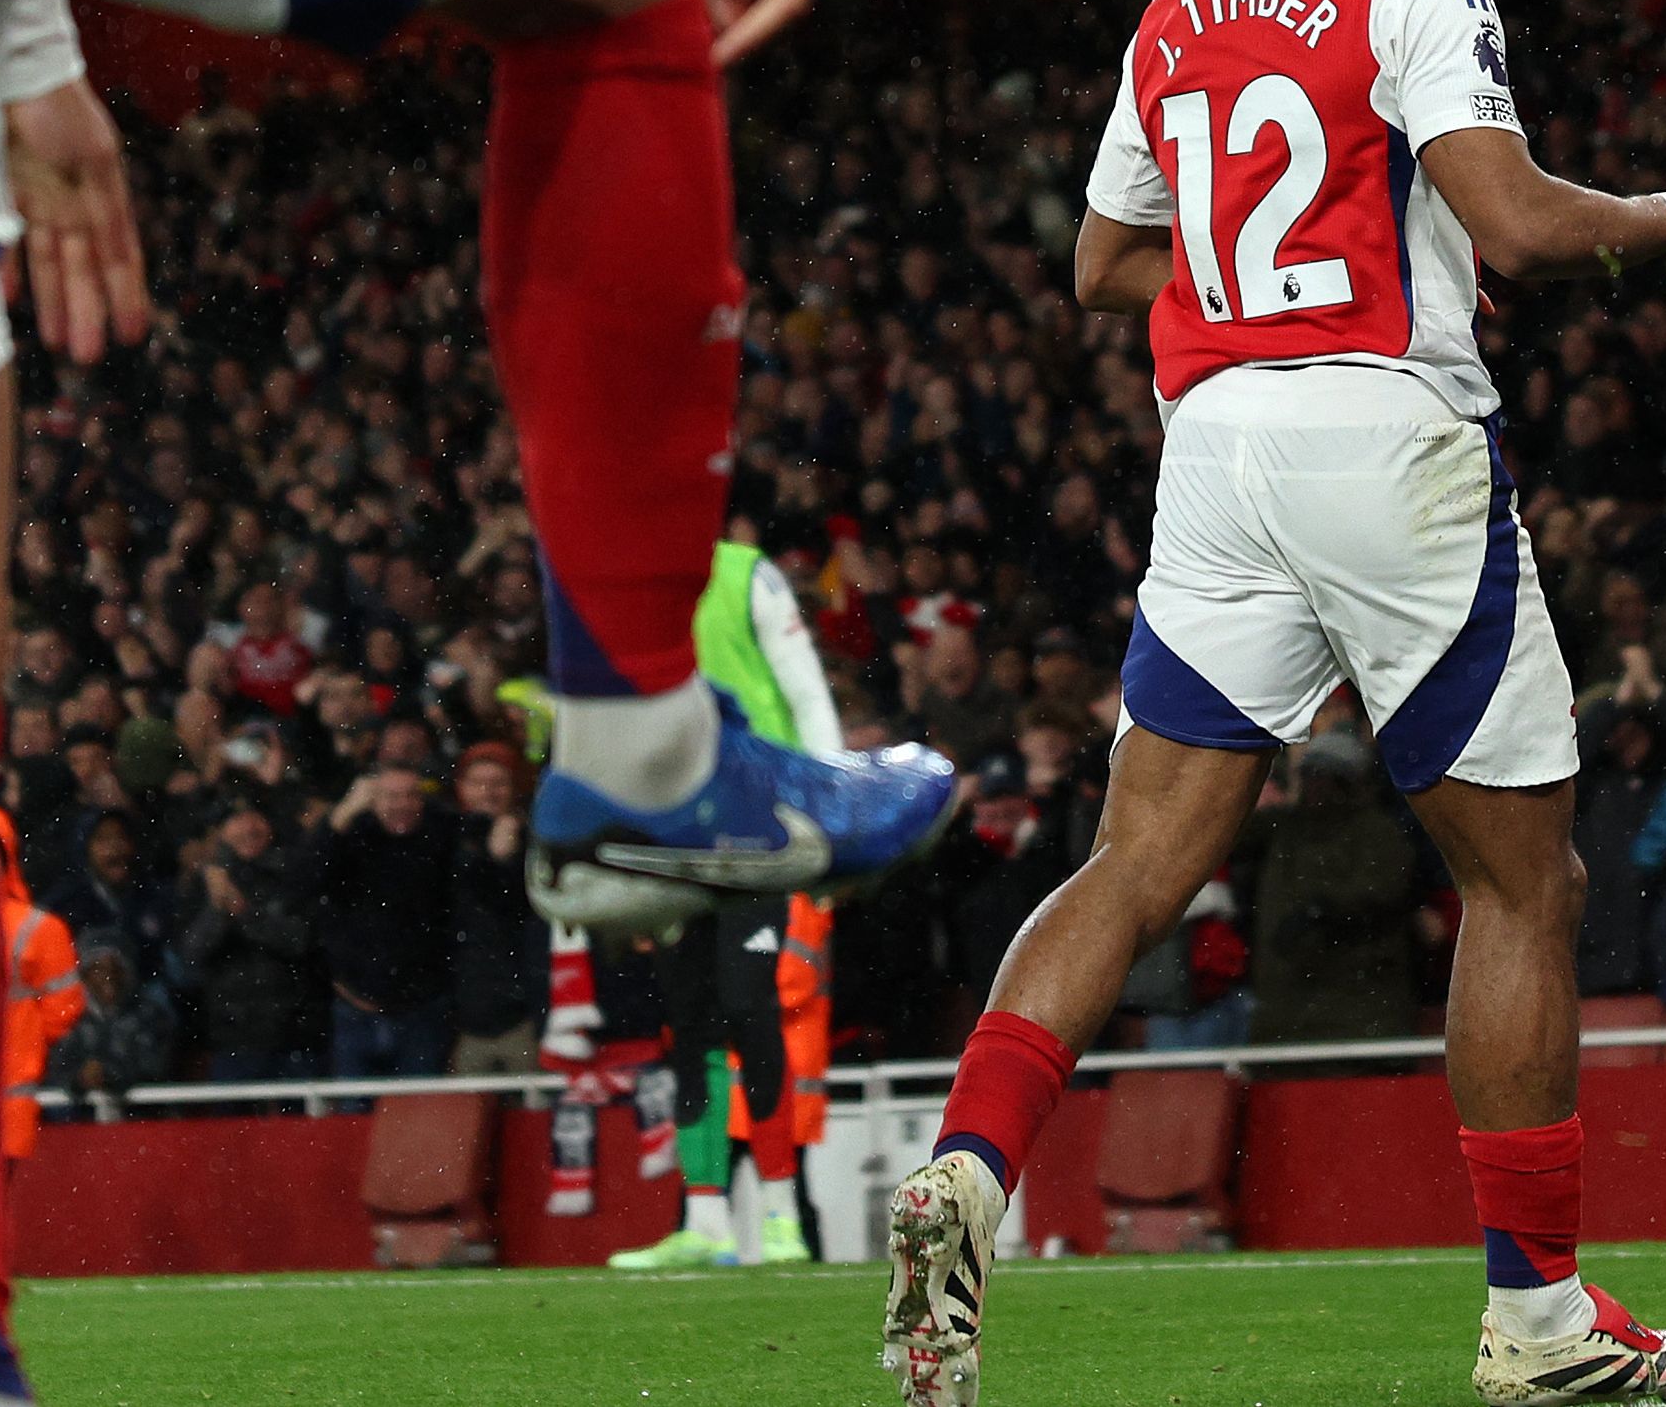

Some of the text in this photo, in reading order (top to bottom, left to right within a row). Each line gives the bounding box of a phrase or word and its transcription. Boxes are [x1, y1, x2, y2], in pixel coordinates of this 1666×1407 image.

[1157, 37, 1182, 77] J.
[1470, 95, 1493, 110] No
[1160, 73, 1355, 324] 12
